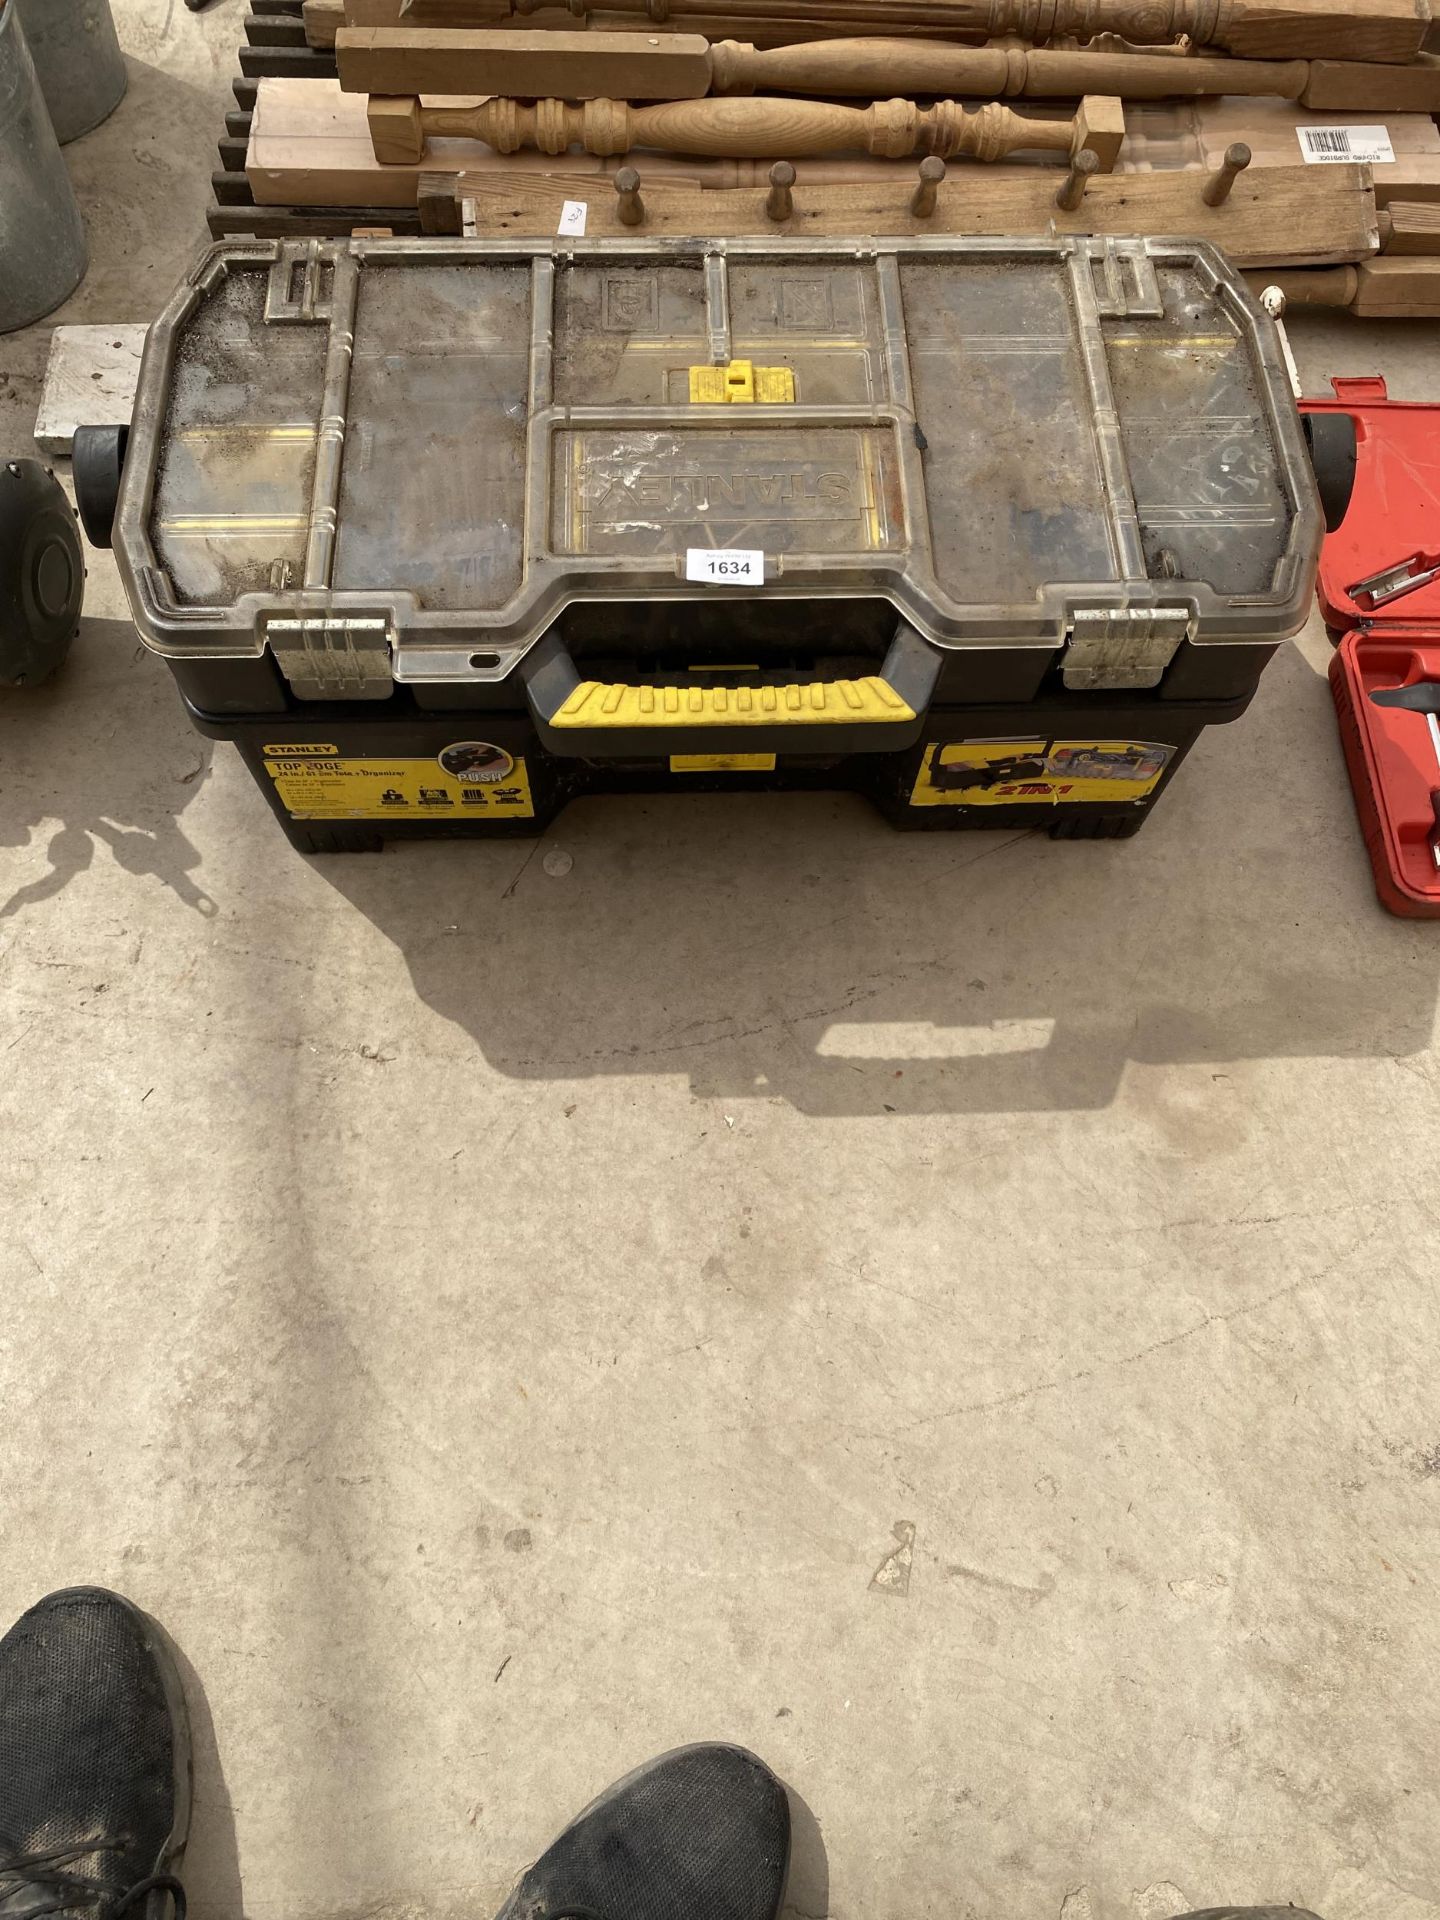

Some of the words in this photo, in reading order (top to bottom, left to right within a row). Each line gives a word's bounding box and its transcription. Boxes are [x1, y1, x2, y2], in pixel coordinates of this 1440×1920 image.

[599, 472, 850, 506] STANLEY
[707, 561, 752, 575] 1634
[268, 746, 332, 754] STANLEY
[274, 762, 302, 771] TOP
[456, 772, 503, 782] PUSH
